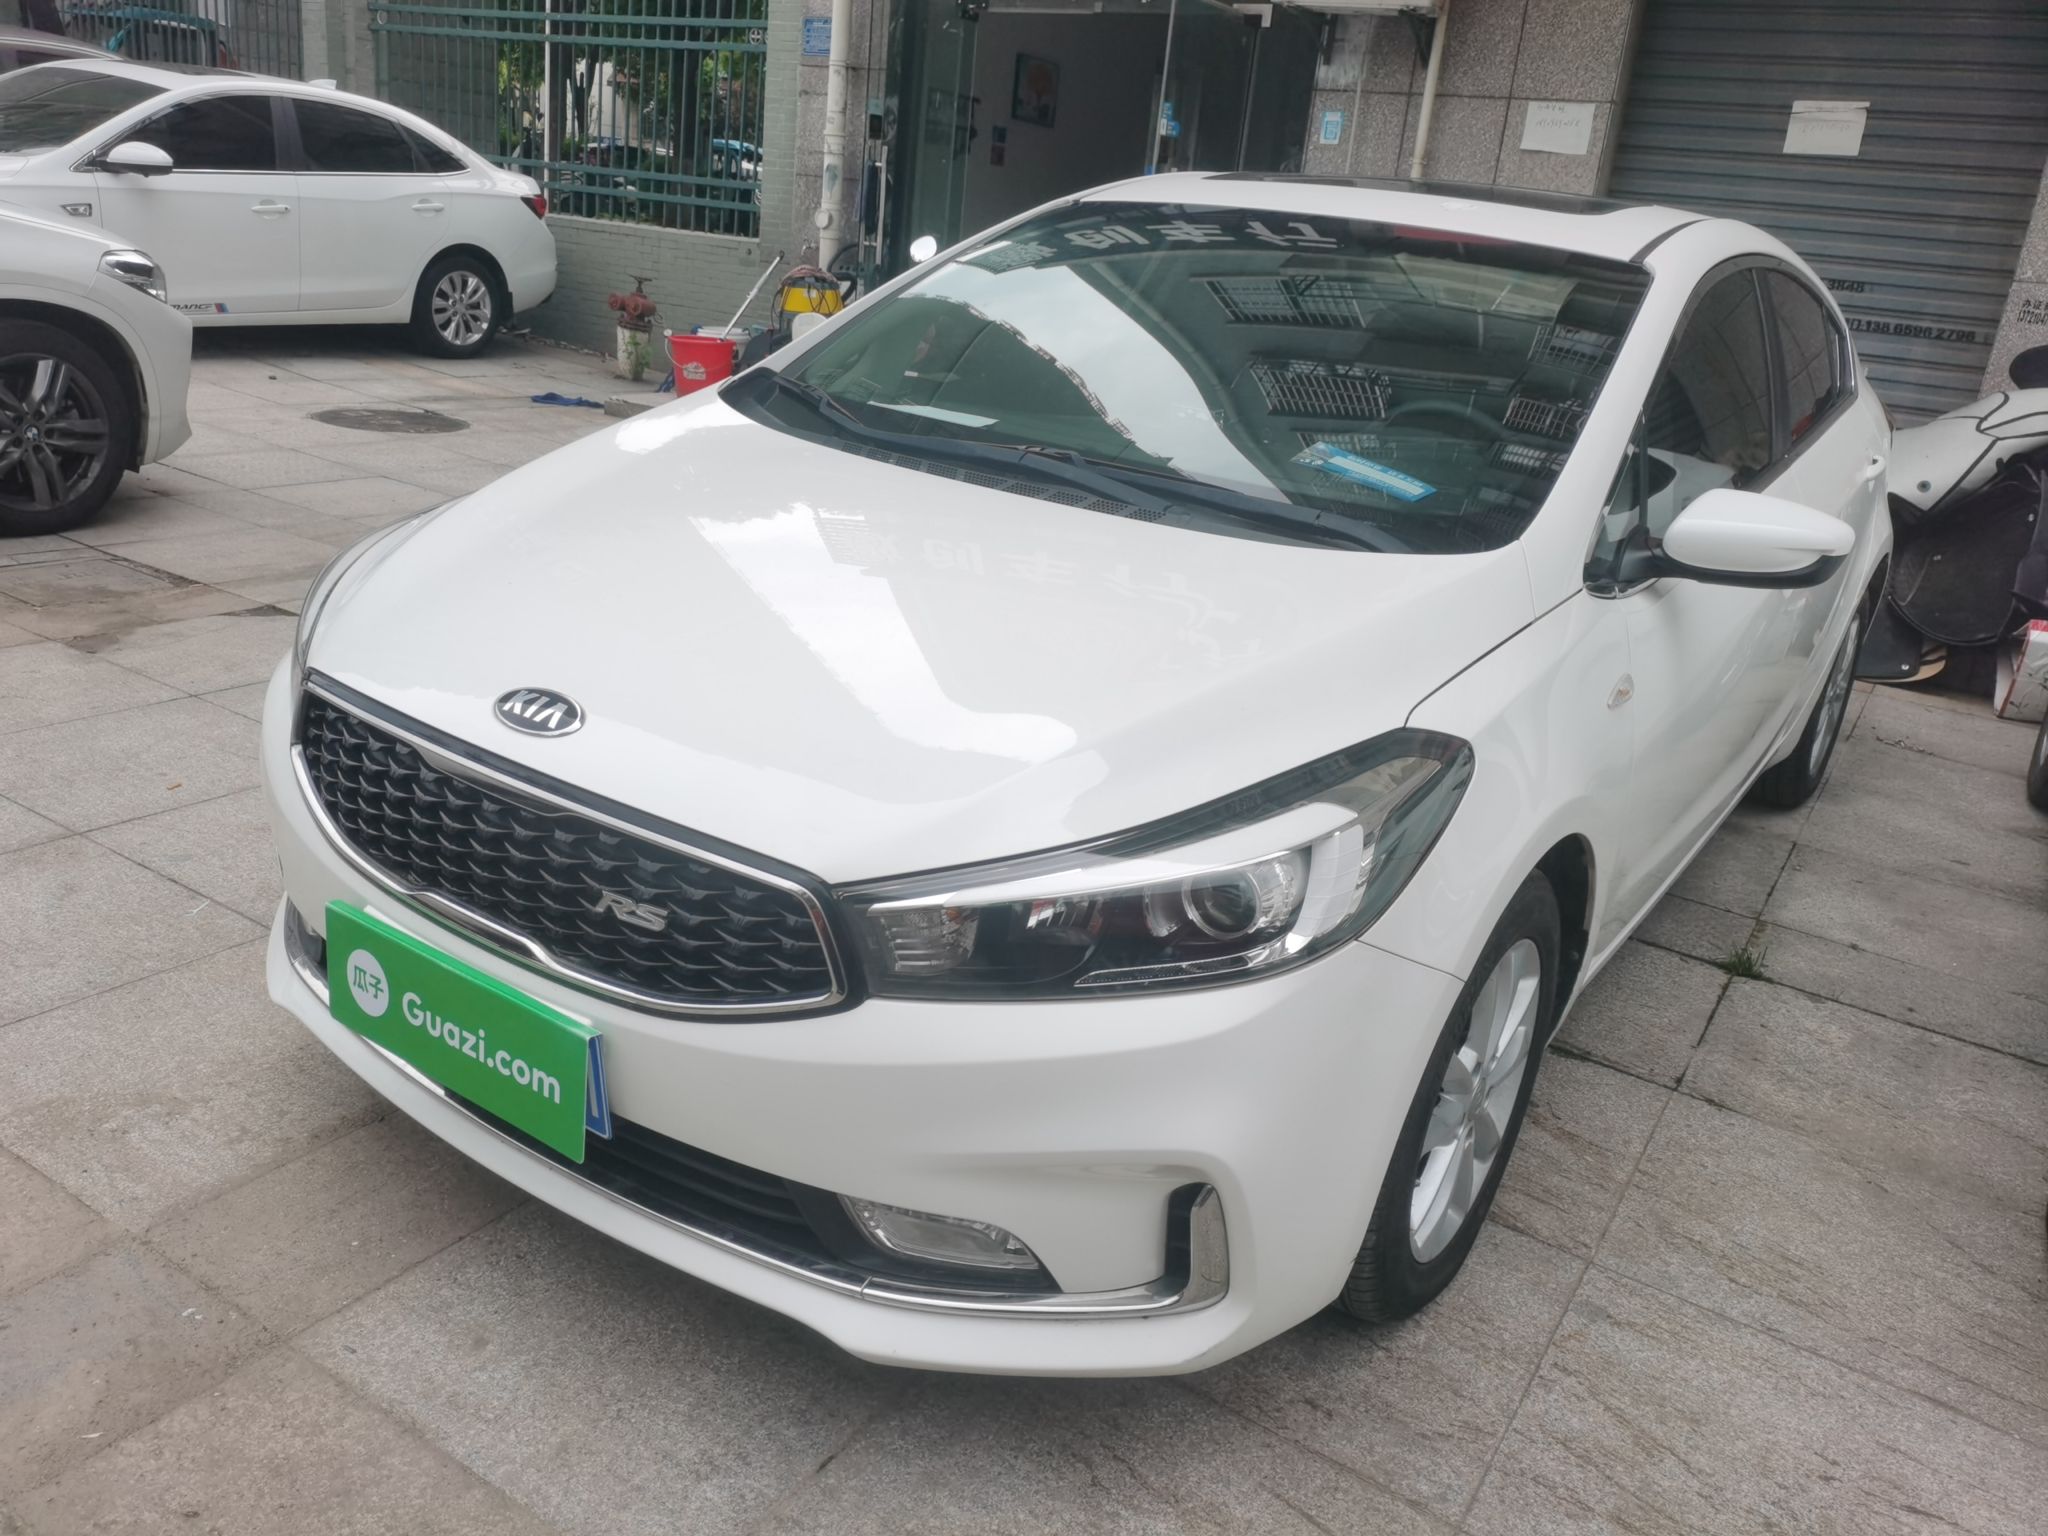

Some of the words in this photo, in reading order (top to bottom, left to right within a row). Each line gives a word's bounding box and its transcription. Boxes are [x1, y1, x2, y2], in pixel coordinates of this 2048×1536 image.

[502, 690, 569, 729] KIA
[595, 889, 669, 932] RS
[353, 964, 384, 999] 瓜子
[402, 991, 561, 1104] Guazi.com
